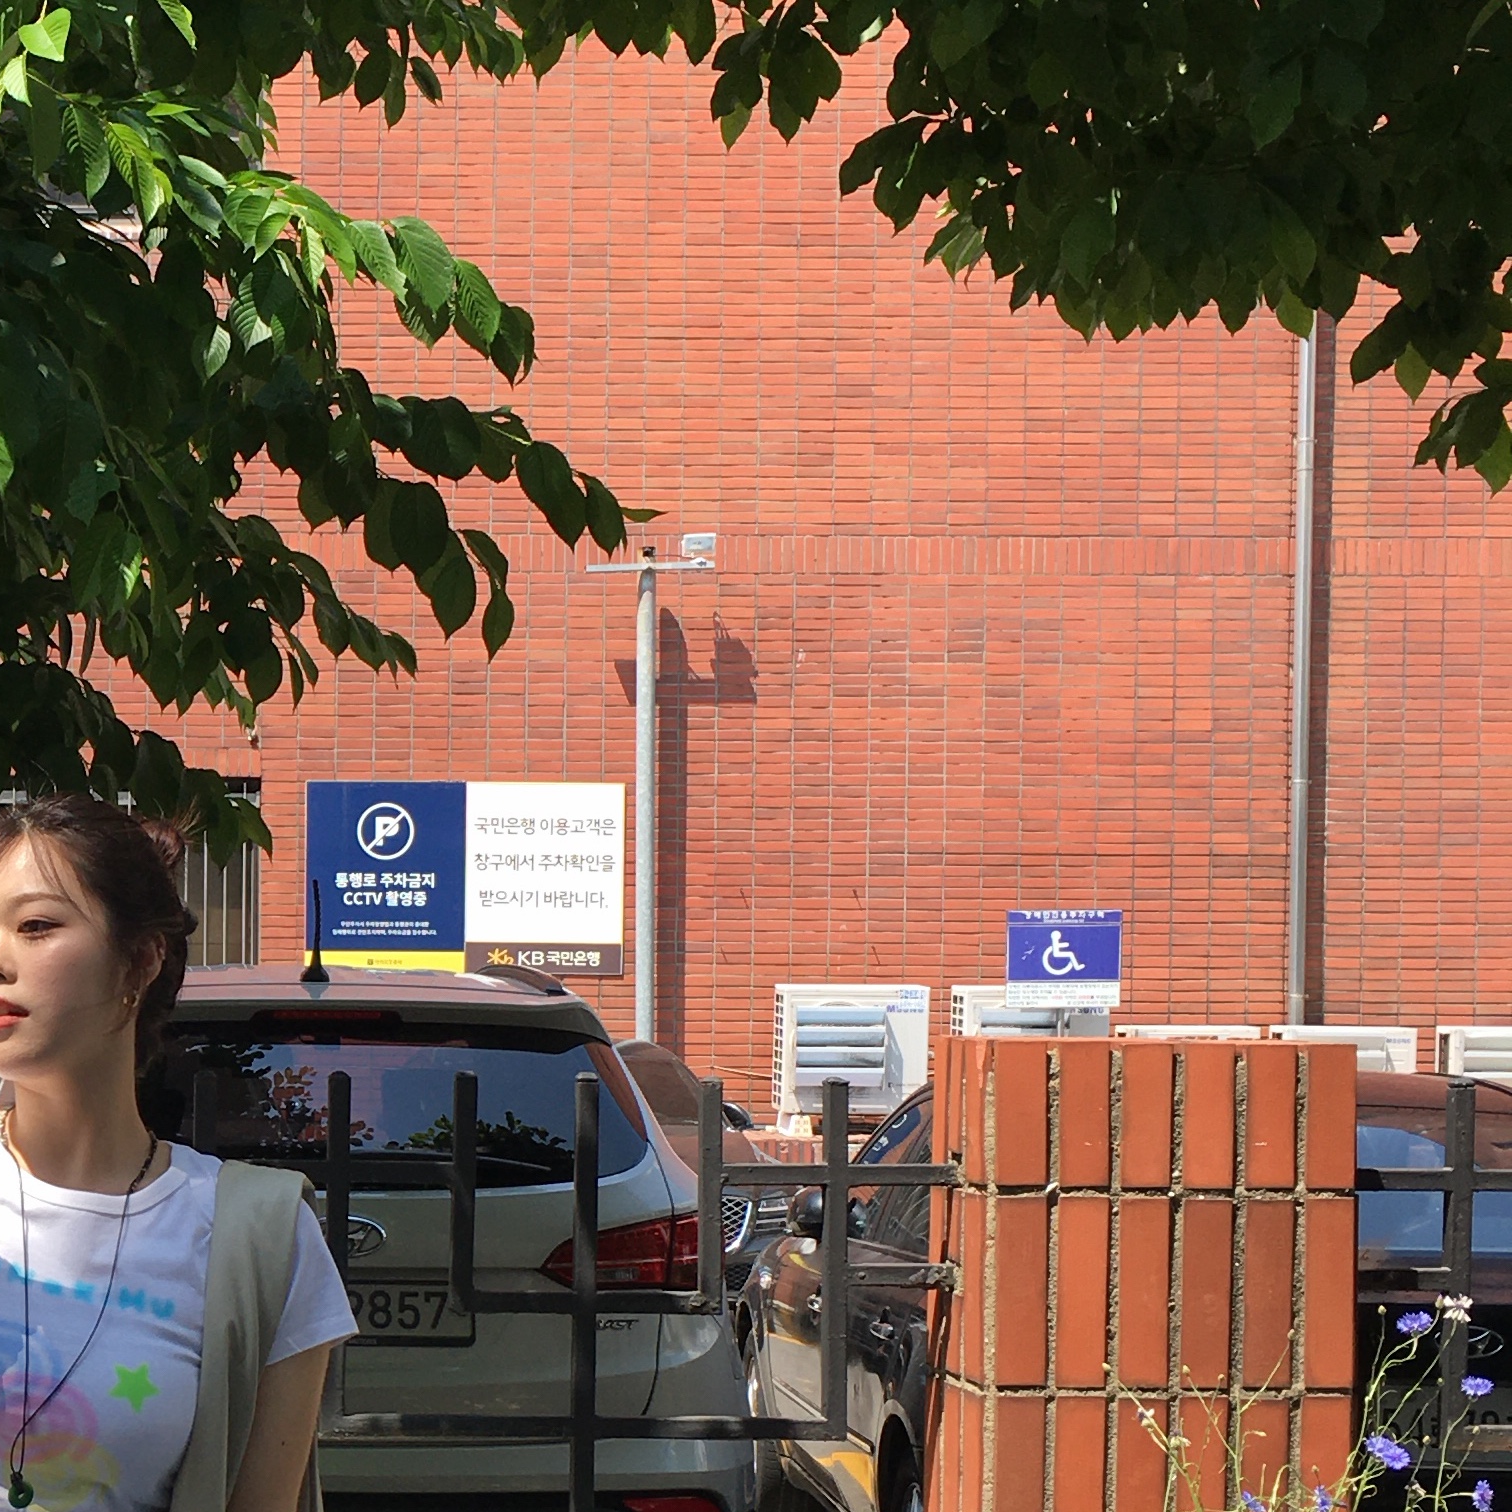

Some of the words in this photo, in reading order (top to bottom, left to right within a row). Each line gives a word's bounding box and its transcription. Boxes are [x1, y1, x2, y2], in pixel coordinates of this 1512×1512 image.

[474, 817, 536, 836] 국민은행
[540, 817, 616, 836] 이용고객은
[474, 853, 534, 871] 창구에서
[538, 854, 616, 872] 주차확인을
[335, 872, 377, 889] 통행로
[380, 872, 435, 889] 주차금지
[343, 891, 383, 906] CCTV
[385, 891, 427, 907] 촬영중
[479, 890, 539, 908] 받으시기
[543, 890, 608, 909] 바랍니다.
